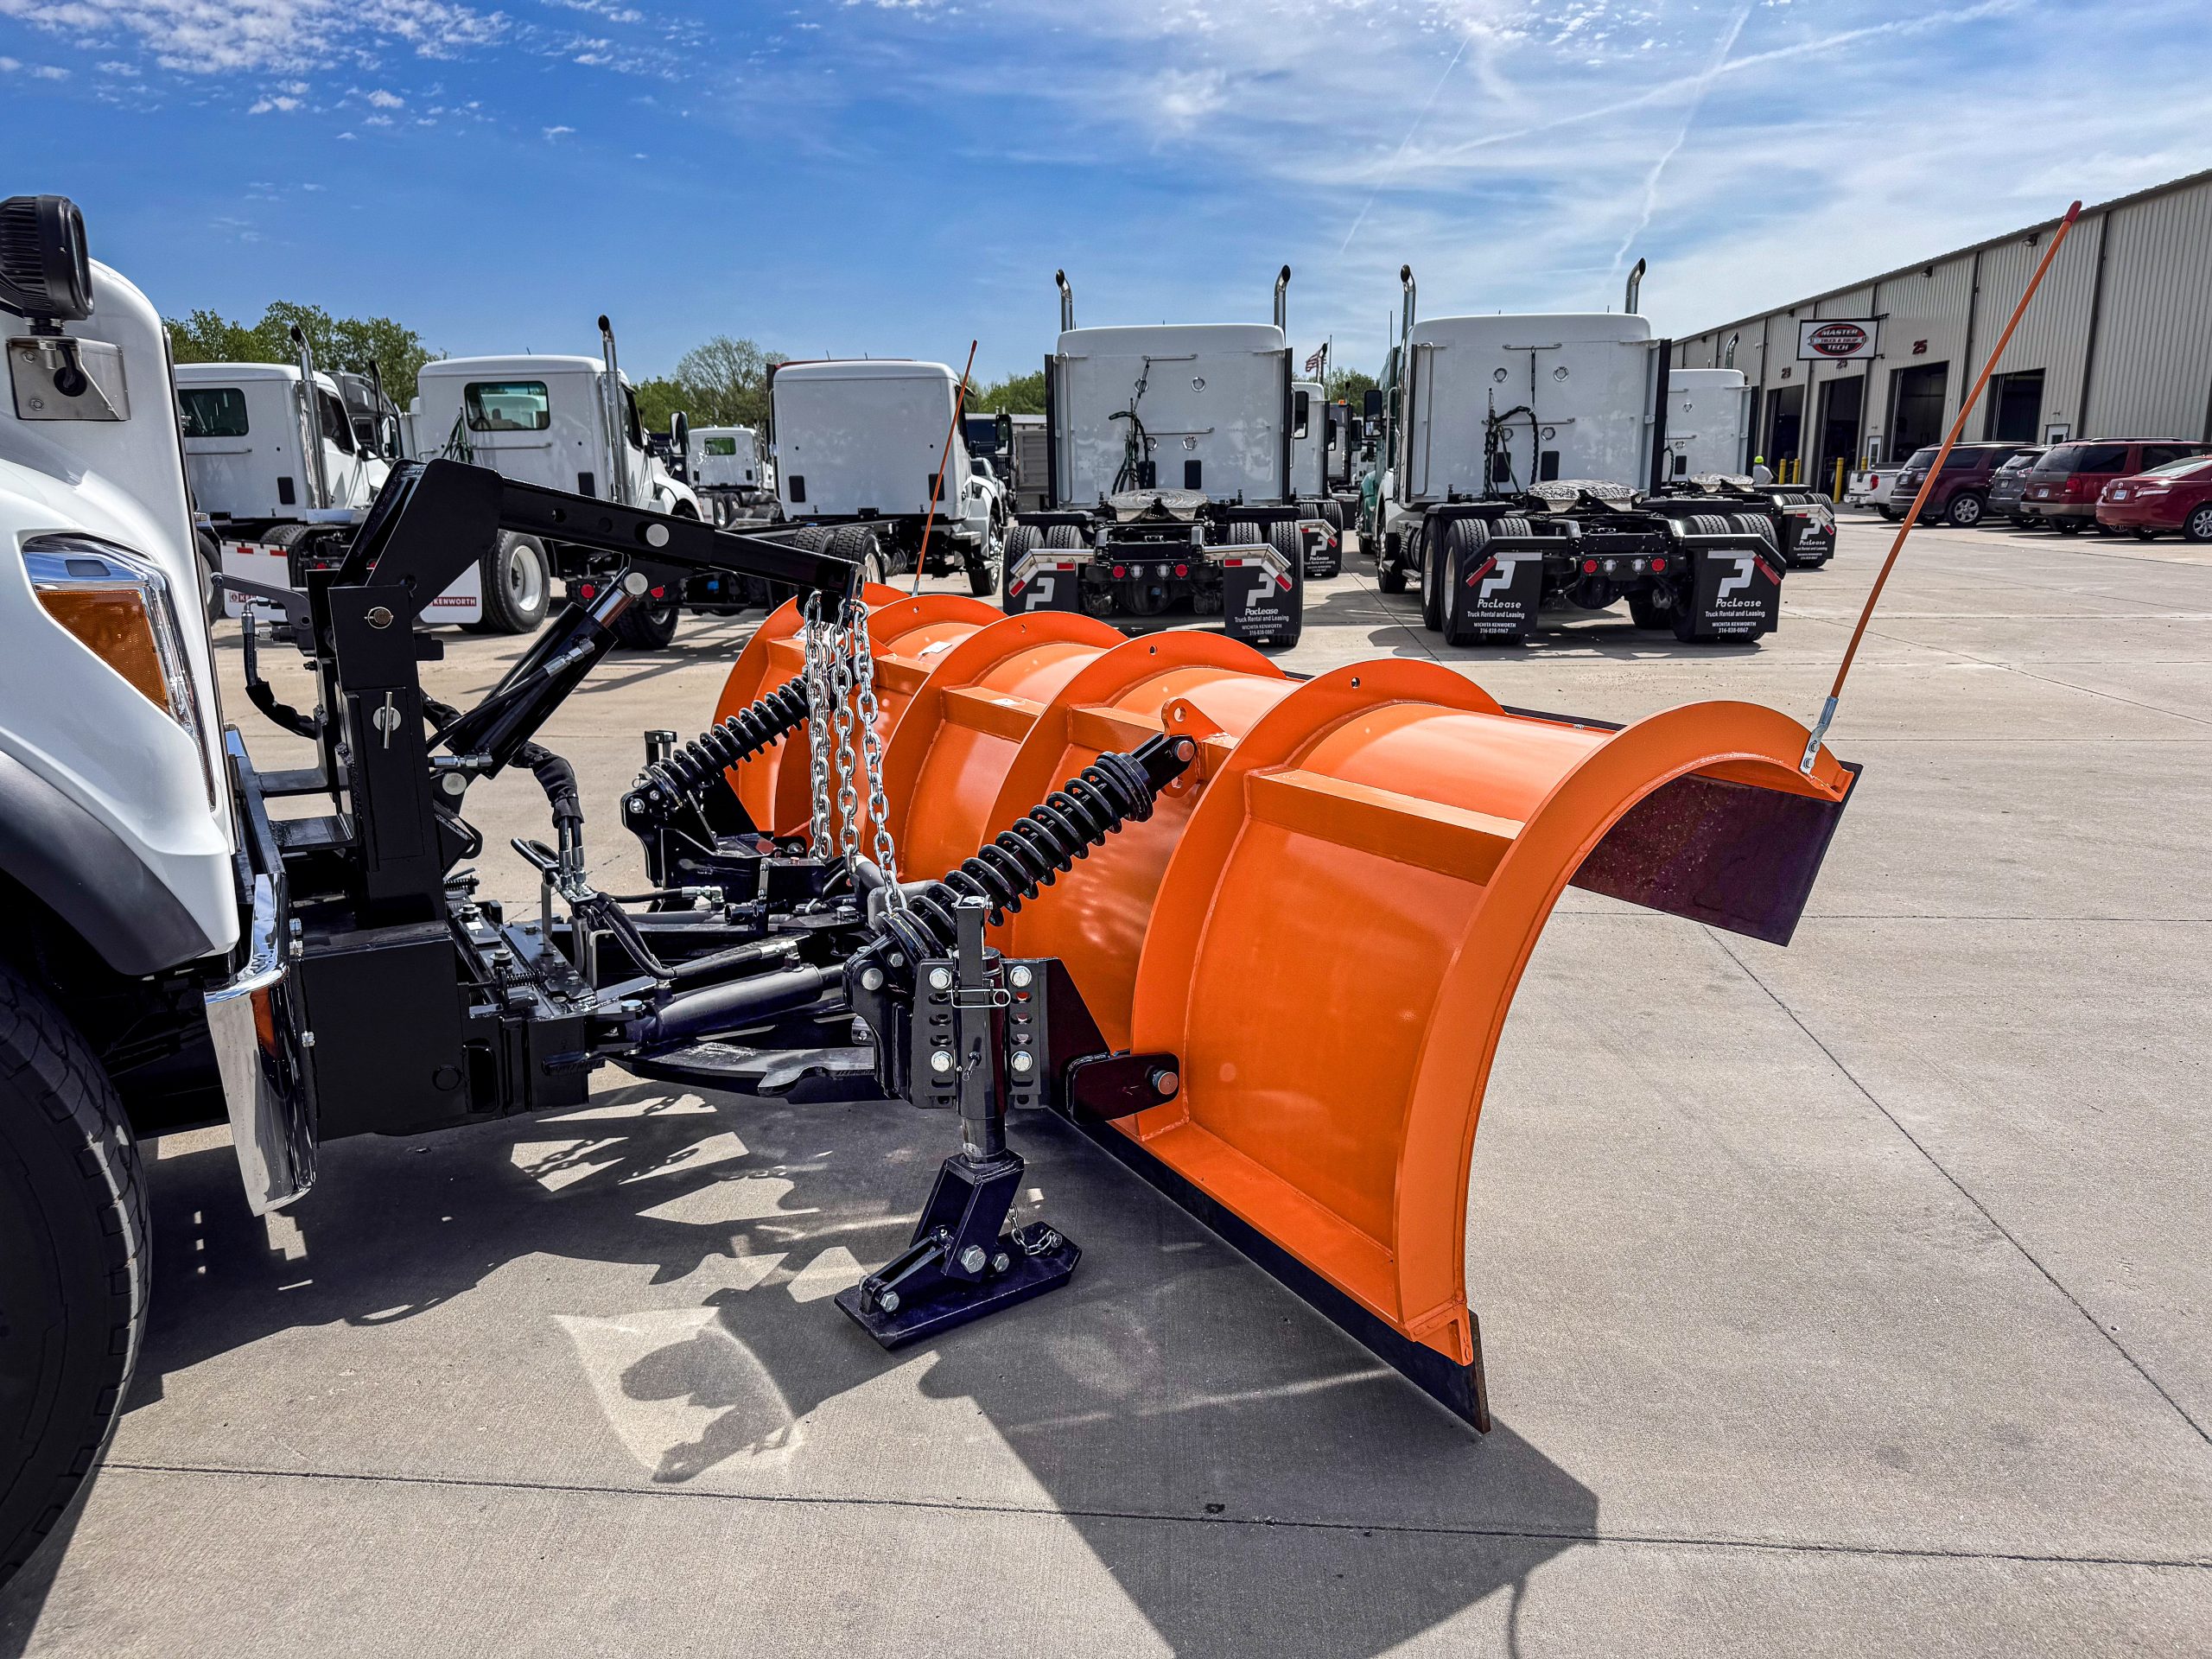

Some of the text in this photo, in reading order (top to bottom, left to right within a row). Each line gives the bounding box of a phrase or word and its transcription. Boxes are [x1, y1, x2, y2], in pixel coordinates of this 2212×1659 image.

[1912, 339, 1928, 355] 25
[1477, 598, 1522, 608] PacLease
[1715, 598, 1762, 607] PacLease
[1245, 607, 1279, 616] PacLease
[1506, 611, 1525, 620] Leasing
[1745, 609, 1765, 618] Leasing
